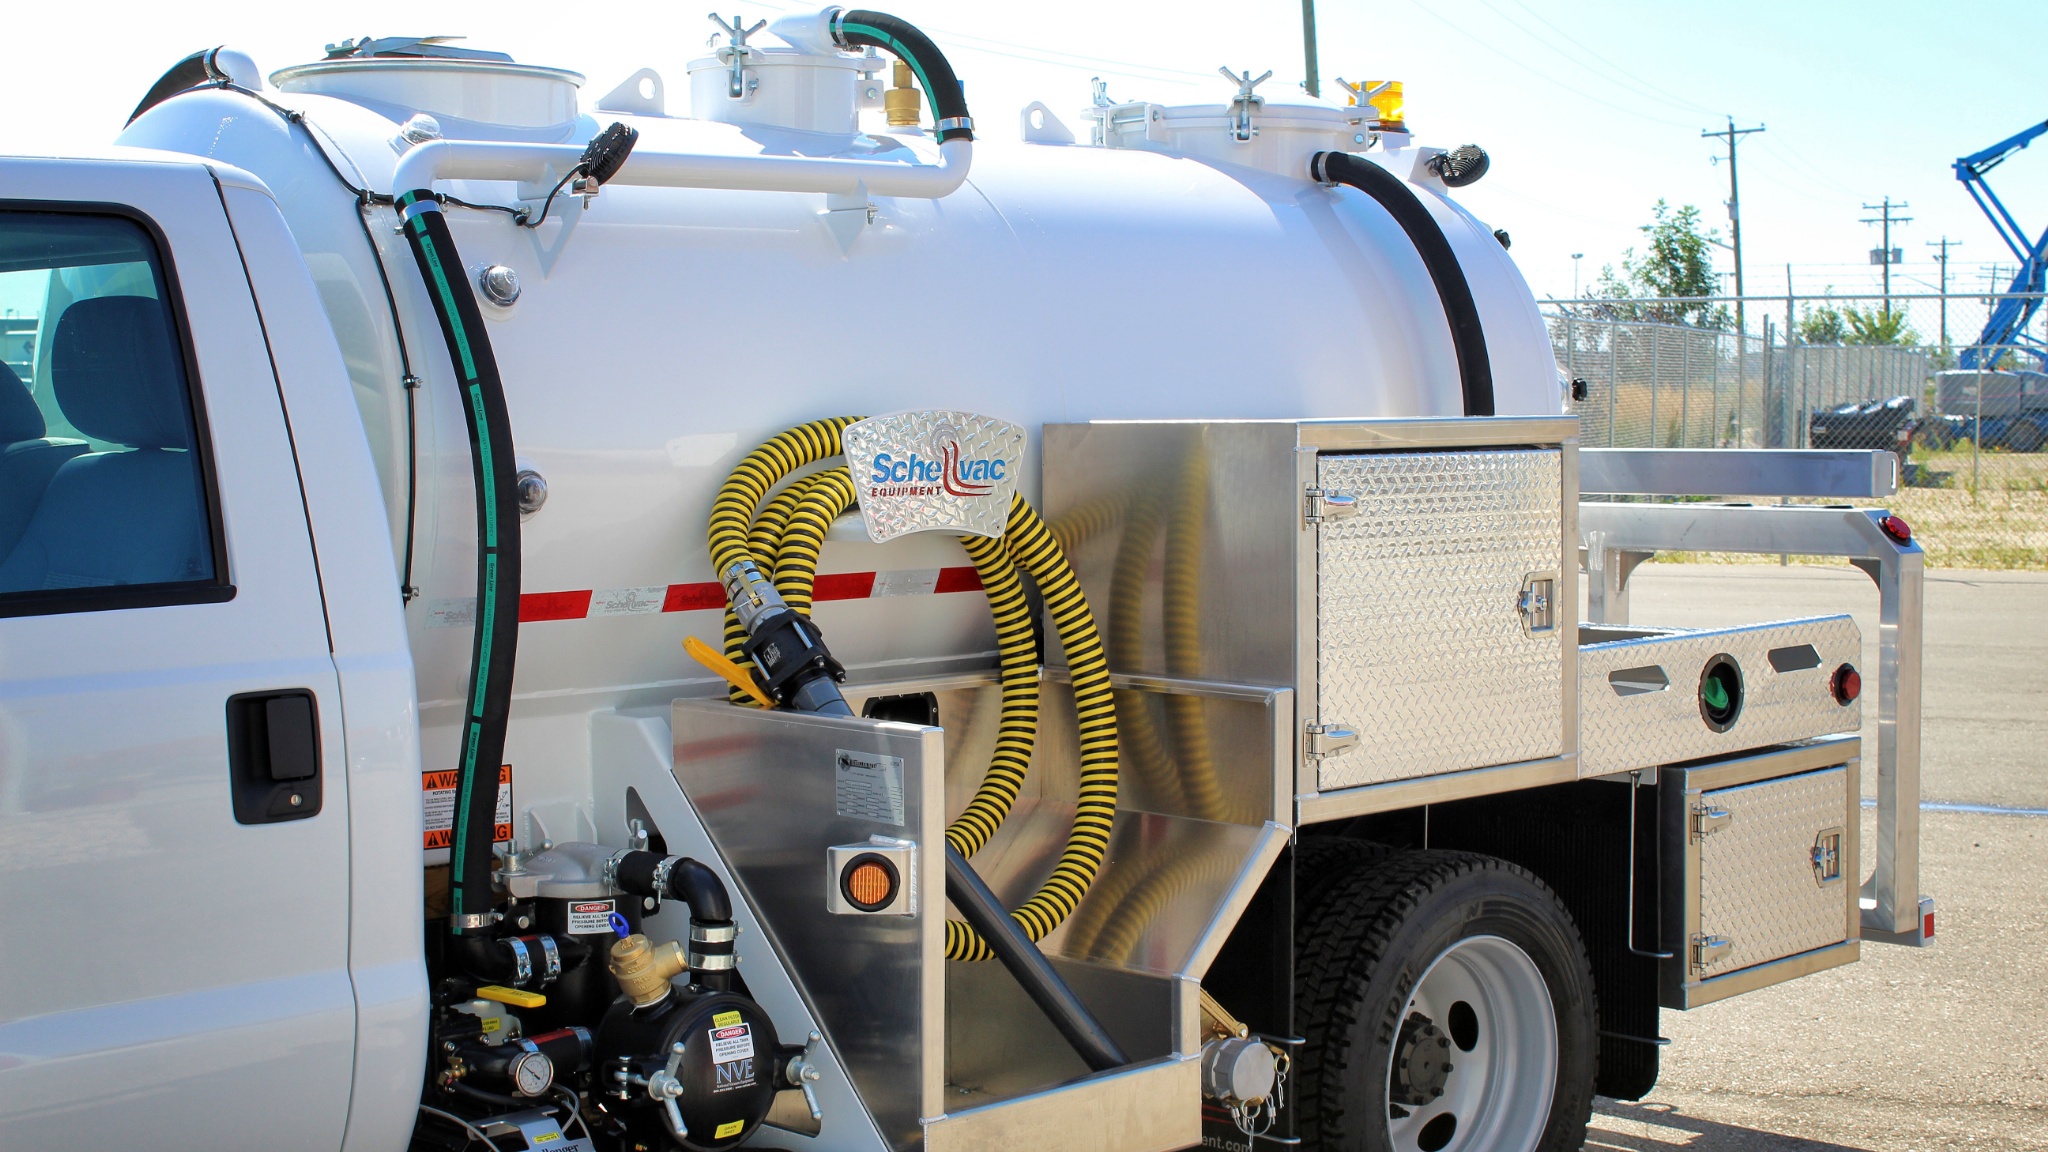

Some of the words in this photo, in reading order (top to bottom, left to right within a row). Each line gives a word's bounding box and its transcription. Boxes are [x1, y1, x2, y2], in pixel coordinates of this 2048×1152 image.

[872, 486, 942, 497] EQUIPMENT
[716, 1058, 755, 1084] NVE
[1202, 1136, 1250, 1152] ent.com
